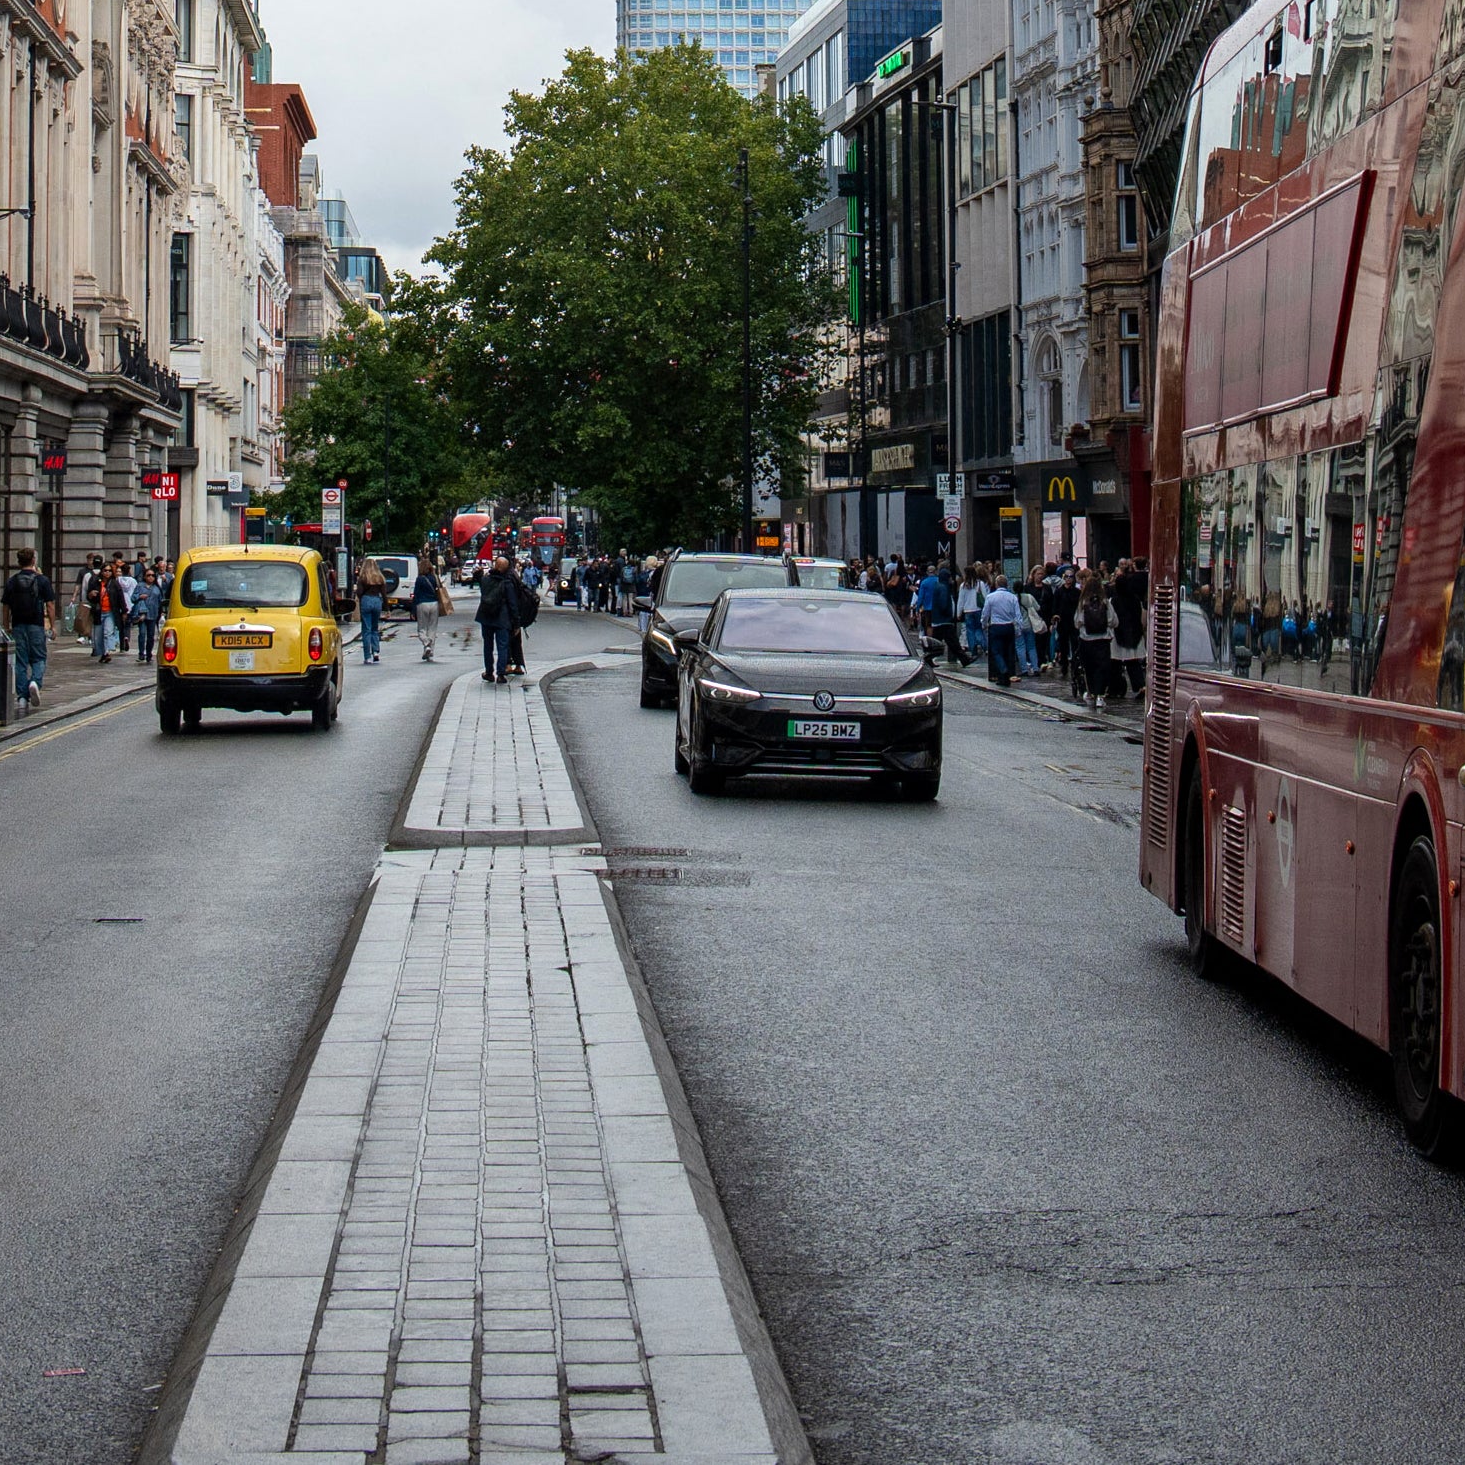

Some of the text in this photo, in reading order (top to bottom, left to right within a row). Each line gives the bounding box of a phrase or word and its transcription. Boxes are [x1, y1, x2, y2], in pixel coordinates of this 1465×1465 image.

[44, 455, 65, 470] H&M
[162, 476, 175, 486] NI
[938, 474, 962, 483] LUH
[154, 487, 176, 498] QLO
[948, 521, 958, 529] 20
[221, 636, 264, 646] KD15 ACX
[795, 723, 855, 737] LP25 BMZ
